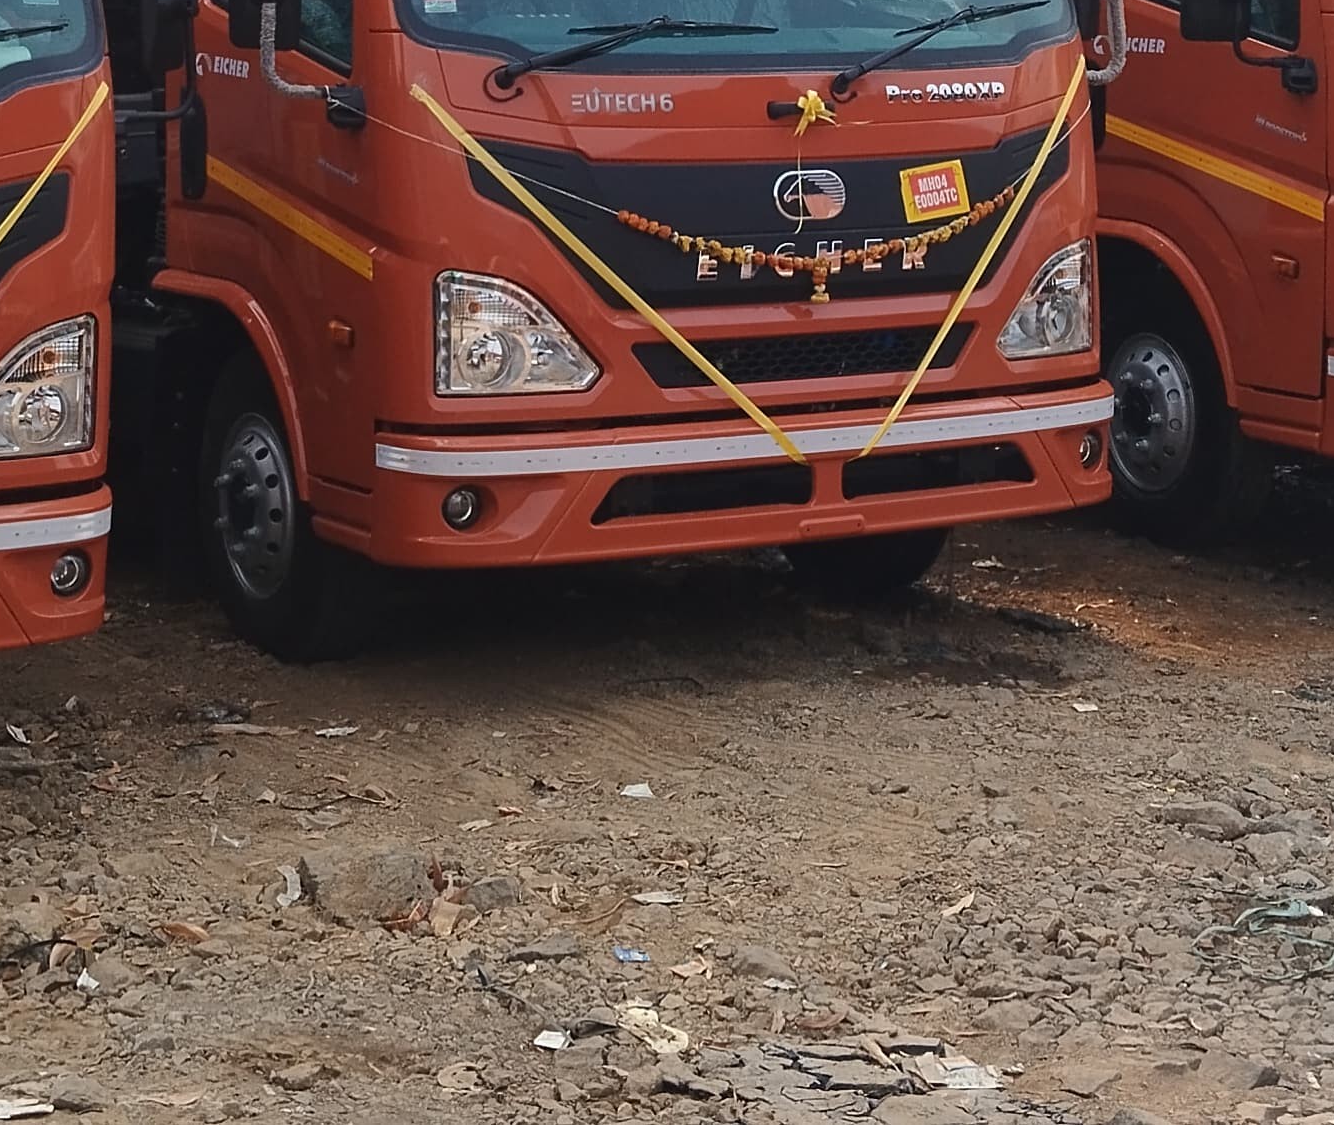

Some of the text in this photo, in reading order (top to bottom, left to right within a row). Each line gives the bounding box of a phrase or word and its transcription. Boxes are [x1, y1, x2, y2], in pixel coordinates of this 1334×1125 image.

[1126, 37, 1166, 54] ICHER
[214, 56, 250, 79] EICHER
[660, 93, 675, 113] 6
[885, 81, 1006, 104] Pro 2080XP
[918, 173, 949, 193] MH04
[914, 187, 958, 209] E0004TC
